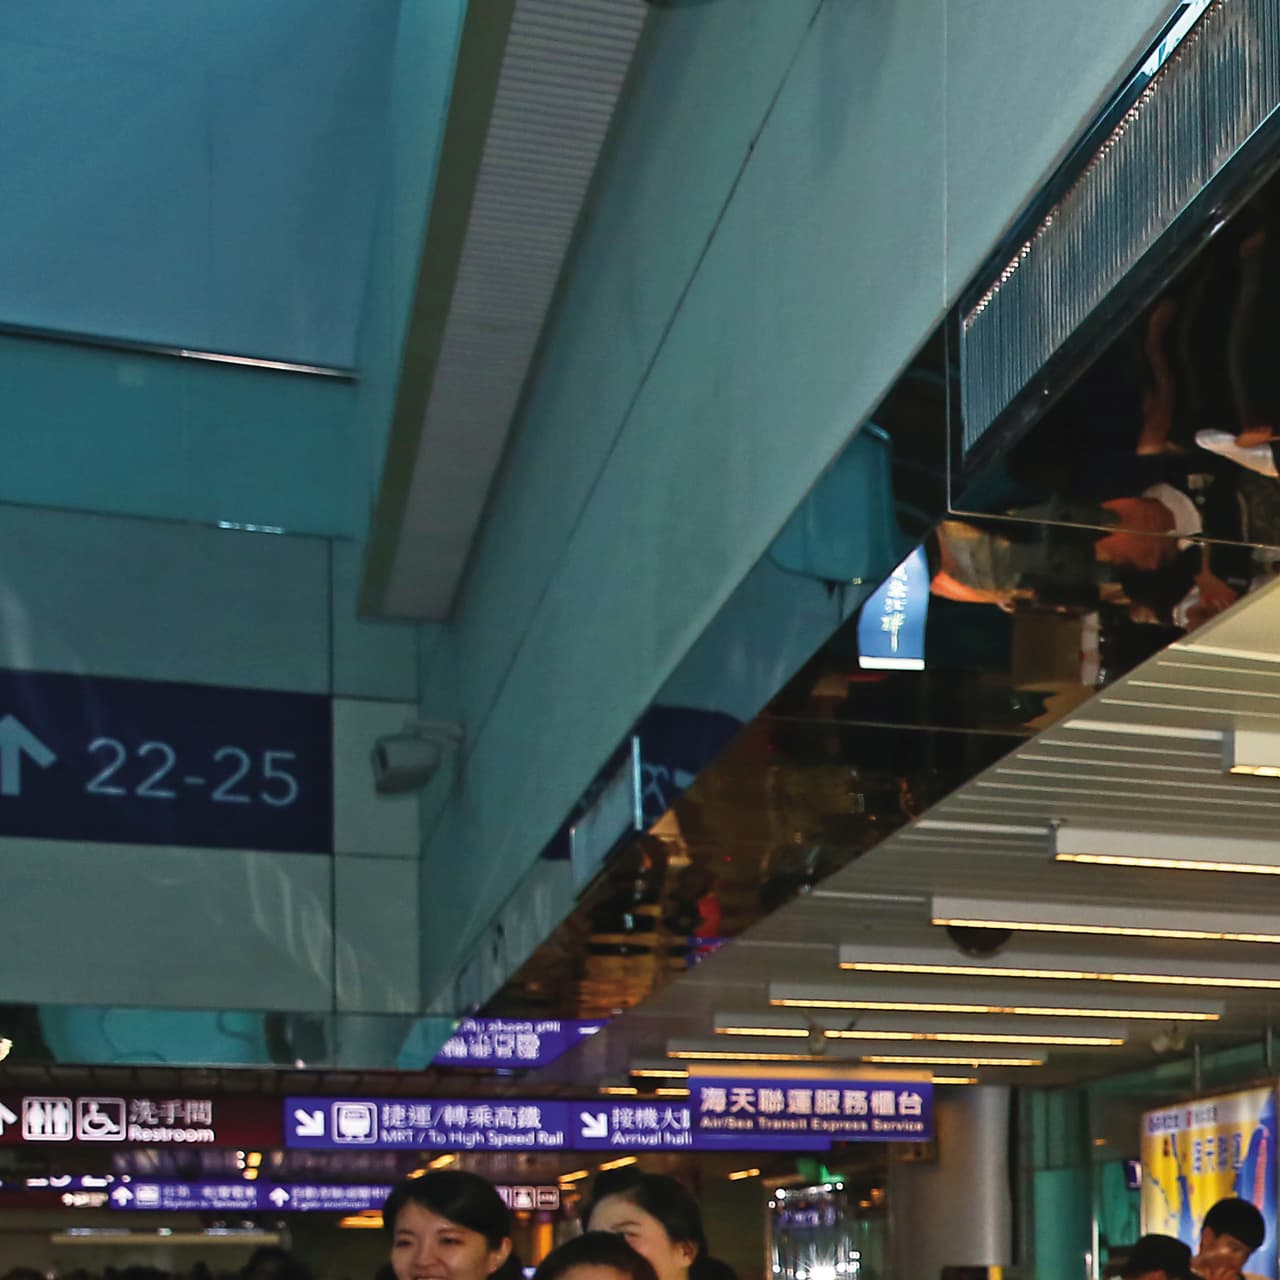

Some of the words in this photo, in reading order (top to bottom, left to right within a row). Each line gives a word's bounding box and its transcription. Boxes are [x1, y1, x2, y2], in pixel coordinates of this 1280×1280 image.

[86, 738, 299, 806] 22-25
[129, 1099, 213, 1125] 洗手間
[701, 1087, 923, 1116] 海天聯運服務櫃台
[382, 1104, 543, 1129] 捷運/轉乘高鐵
[612, 1106, 691, 1130] 接機大
[701, 1115, 754, 1130] Air/Sea
[758, 1116, 807, 1130] Transit
[811, 1118, 868, 1133] Express
[872, 1119, 924, 1132] Service
[129, 1124, 215, 1142] Restroom
[382, 1130, 415, 1143] MRT
[450, 1131, 485, 1147] High
[488, 1131, 535, 1147] Speed
[538, 1131, 564, 1145] Rail
[612, 1131, 661, 1146] Arrival
